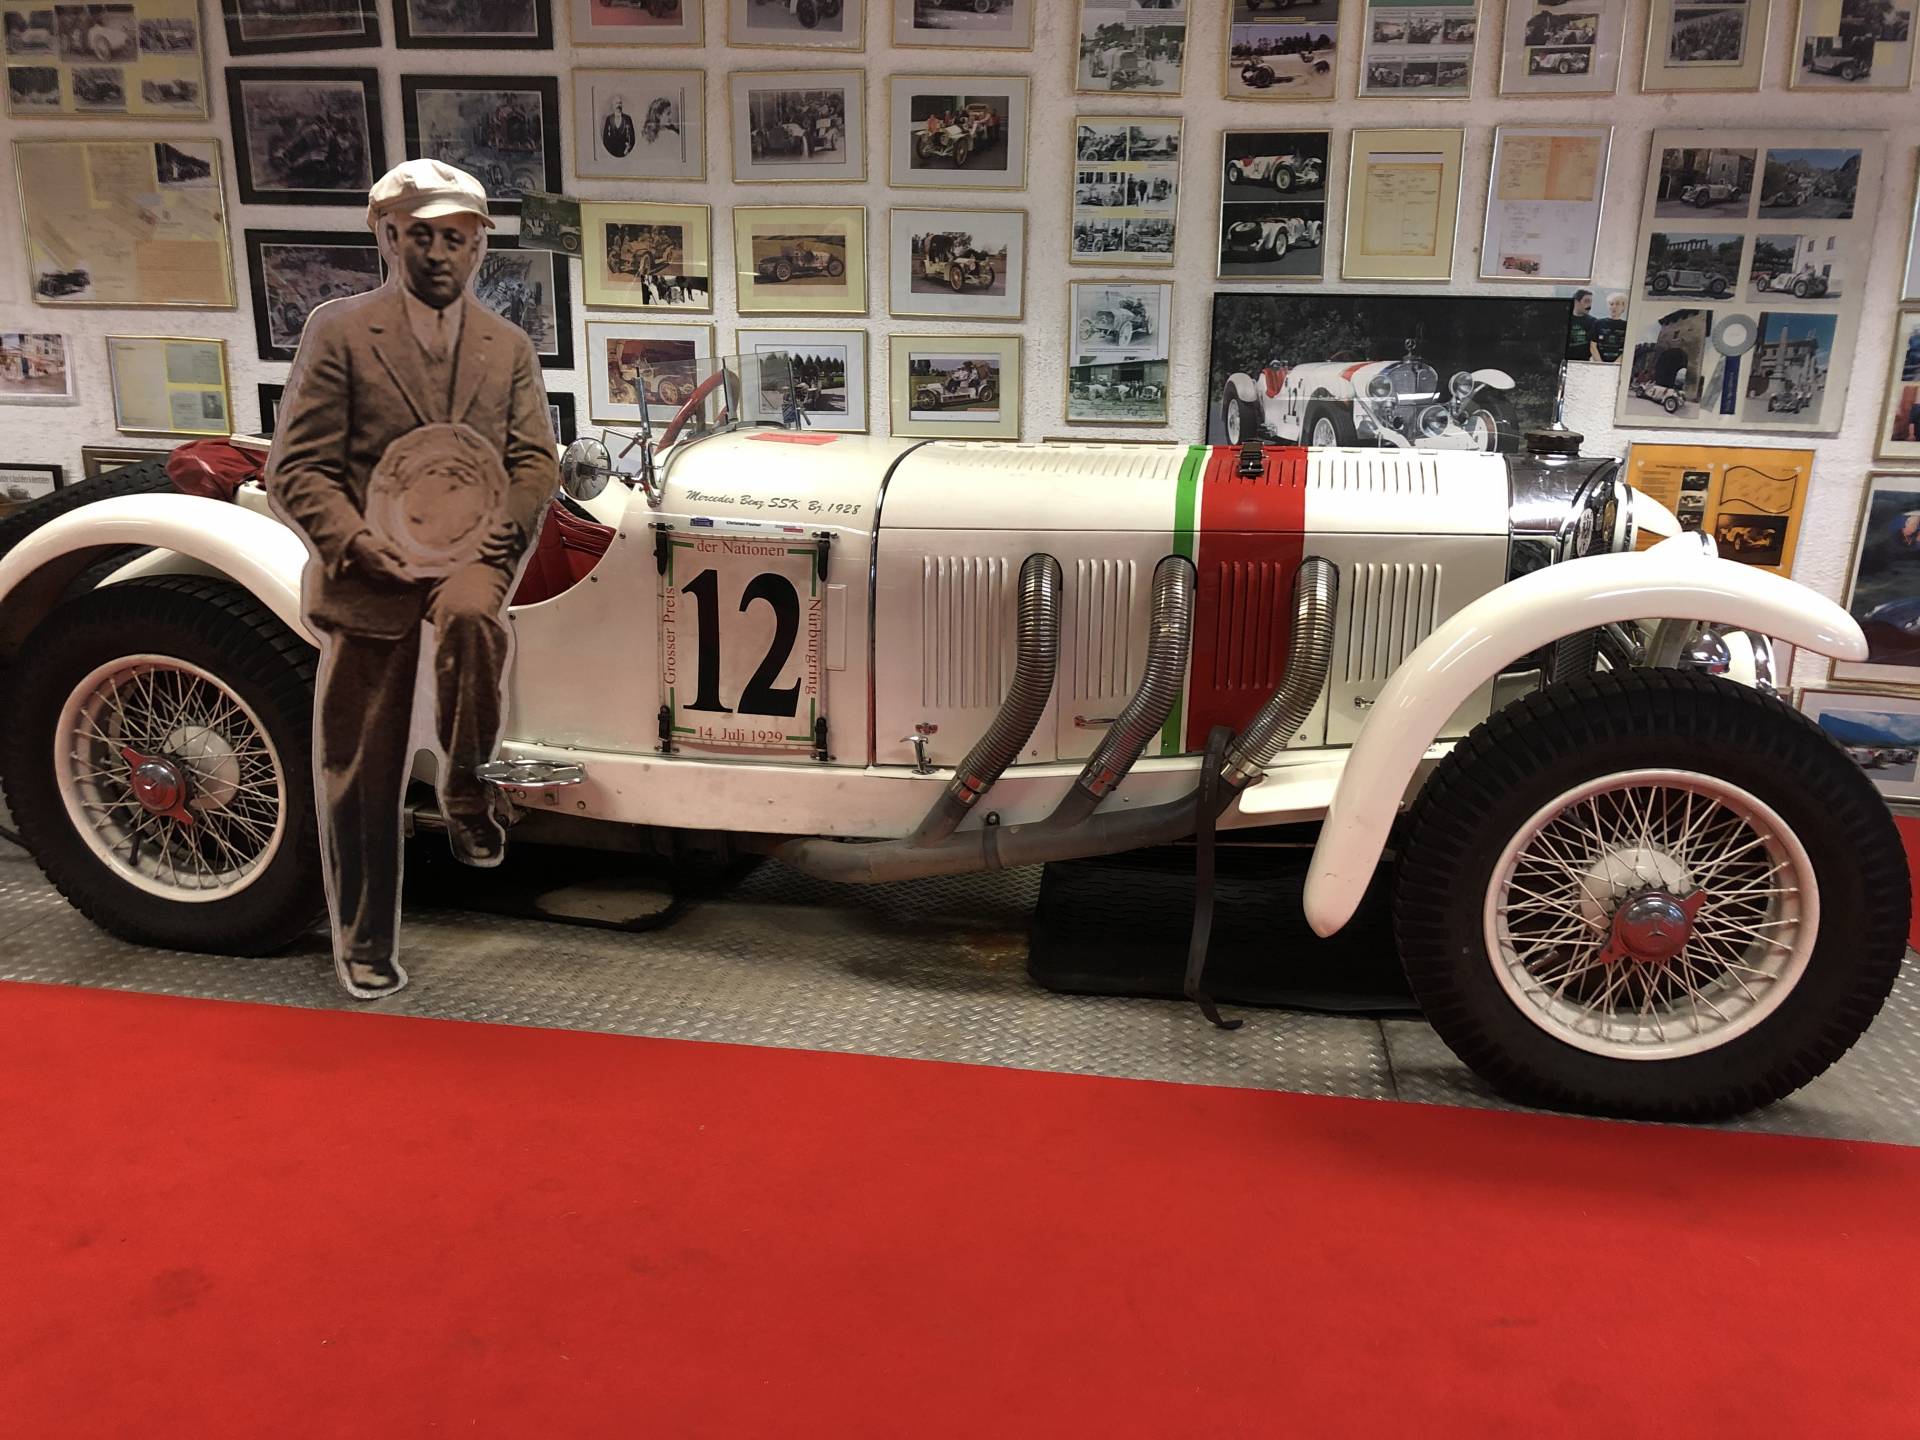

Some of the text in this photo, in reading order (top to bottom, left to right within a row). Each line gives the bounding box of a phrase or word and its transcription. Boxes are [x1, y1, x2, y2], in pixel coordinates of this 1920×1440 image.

[1287, 387, 1298, 416] 12
[687, 490, 734, 504] Mercedes
[740, 494, 766, 510] Benz
[768, 497, 801, 510] SSK
[827, 503, 862, 515] 1928
[697, 539, 785, 557] der Nationen
[664, 587, 676, 684] Grosser Preis
[681, 569, 802, 718] 12
[805, 599, 821, 695] Nürburgring
[699, 726, 783, 743] 14. Juli 1929
